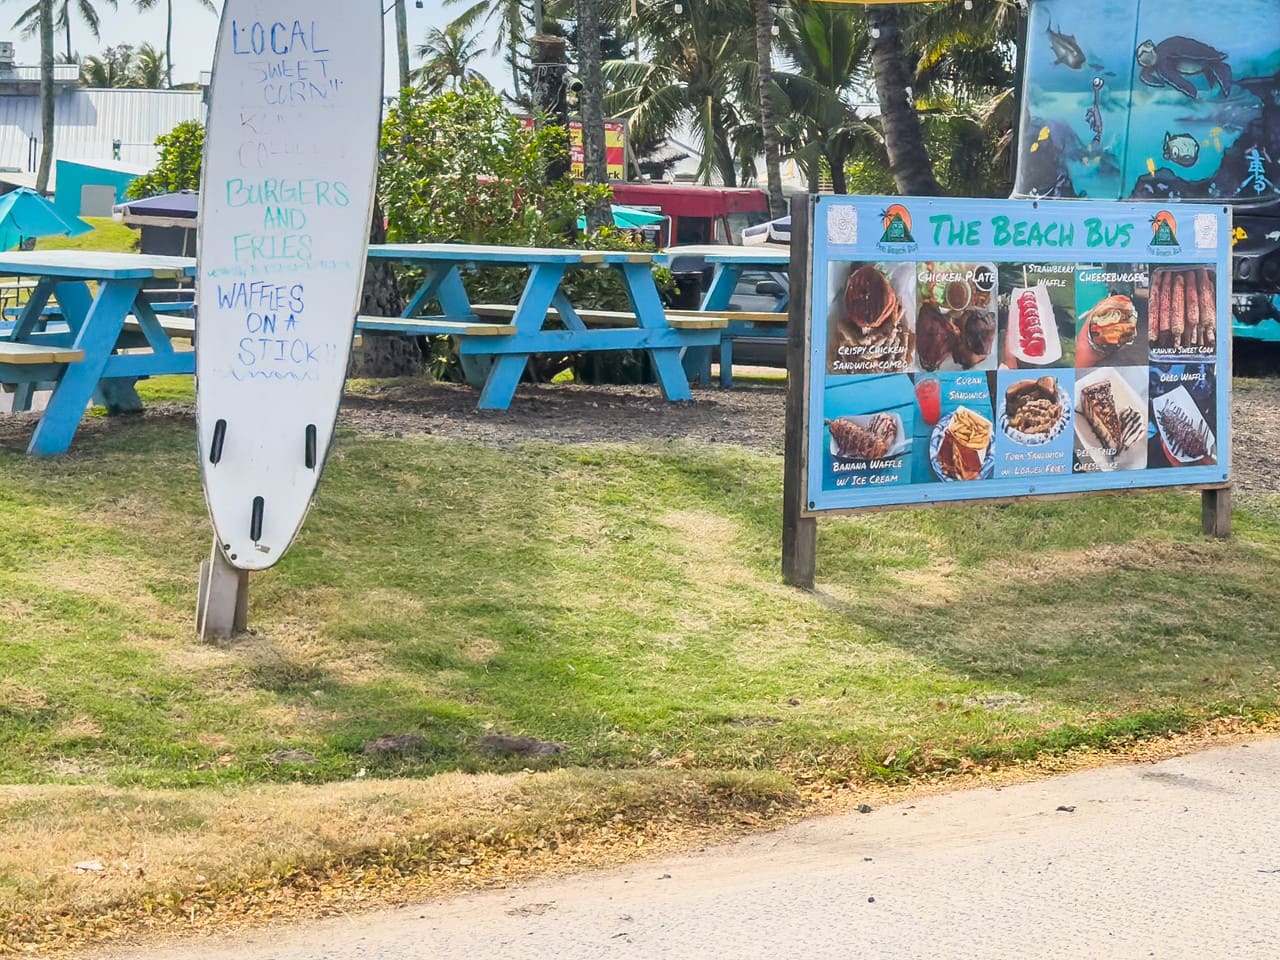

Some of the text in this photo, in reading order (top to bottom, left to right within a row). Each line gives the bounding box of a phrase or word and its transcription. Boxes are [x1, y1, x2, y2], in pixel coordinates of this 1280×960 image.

[232, 19, 329, 56] LOCAL
[248, 58, 329, 83] SWEET
[226, 177, 351, 208] BURGERS
[263, 207, 306, 231] AND
[928, 213, 1135, 248] THE BEACH BUS
[233, 233, 313, 263] FRIES
[918, 270, 997, 283] CHICKEN PLATE
[1028, 263, 1075, 274] STRAWBERRY
[1079, 271, 1145, 283] CHEESEBURGER
[1037, 278, 1067, 288] WAFFLE
[217, 280, 305, 314] WAFFLES
[246, 312, 301, 334] ON A
[838, 344, 867, 356] CRISPY
[832, 458, 903, 472] BANANA WAFFLE
[851, 475, 867, 486] ICE
[869, 474, 899, 485] CREAM
